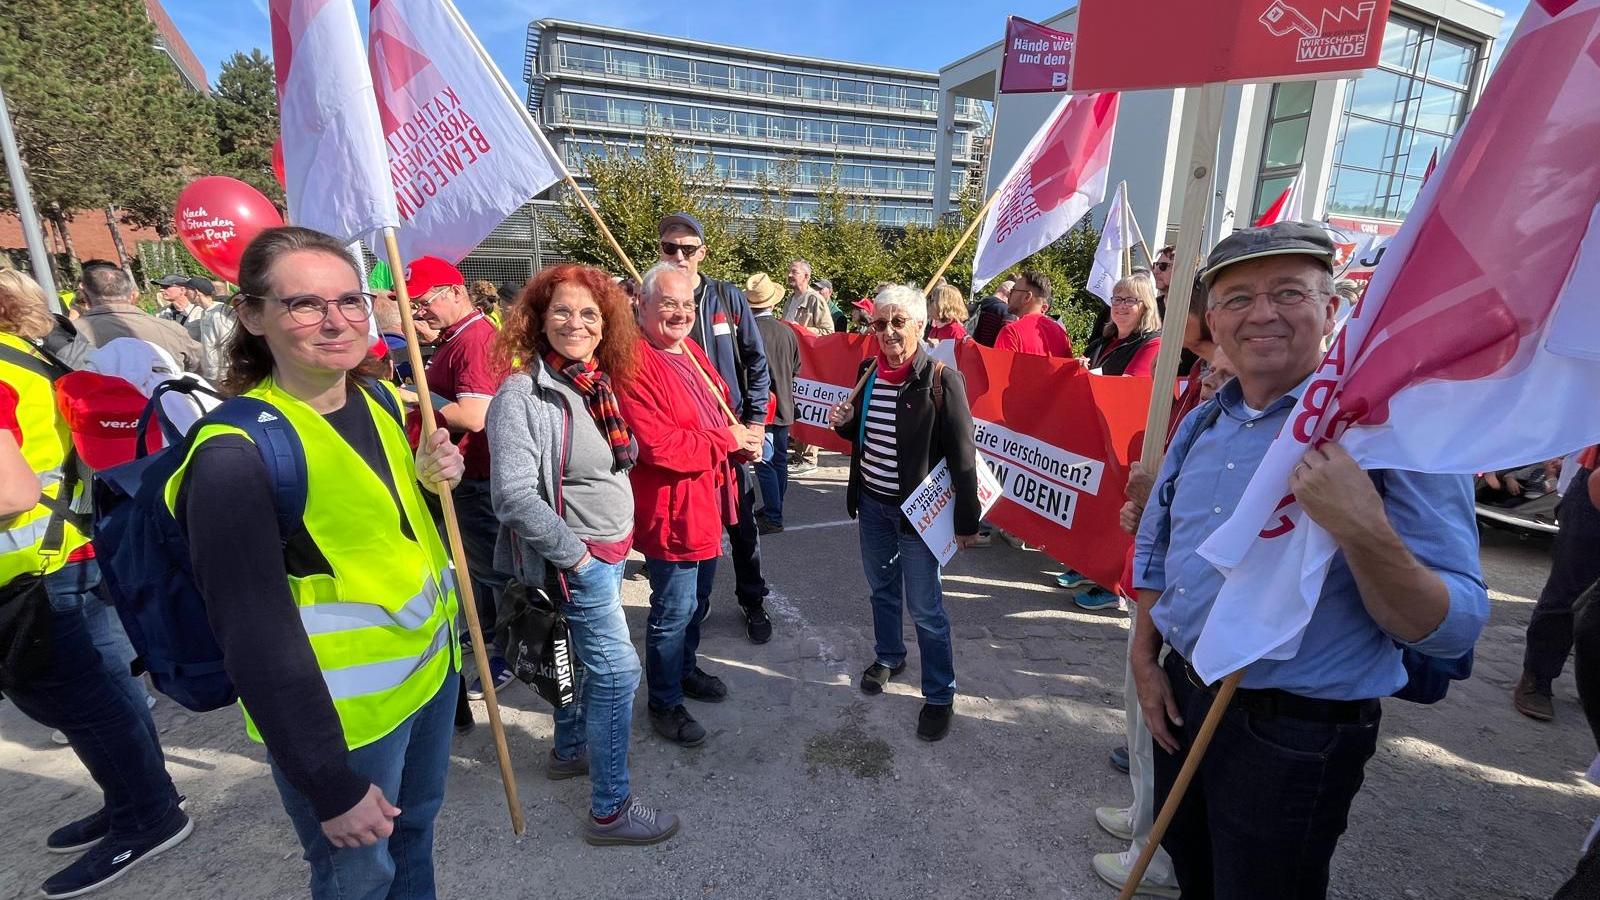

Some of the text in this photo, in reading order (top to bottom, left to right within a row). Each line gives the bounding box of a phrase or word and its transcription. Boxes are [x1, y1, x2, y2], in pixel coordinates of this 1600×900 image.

[1013, 38, 1049, 52] Hände
[1300, 42, 1364, 59] WUNDE
[1019, 53, 1066, 66] und den
[183, 206, 208, 220] Nach
[186, 217, 235, 230] Stunden
[204, 227, 237, 242] Papi
[792, 381, 810, 396] Bei
[813, 386, 834, 402] den
[794, 402, 829, 425] SCHL
[99, 418, 140, 429] ver.d
[1002, 438, 1092, 487] verschonen?
[1012, 473, 1072, 521] OBEN!
[554, 639, 572, 692] MUSIK
